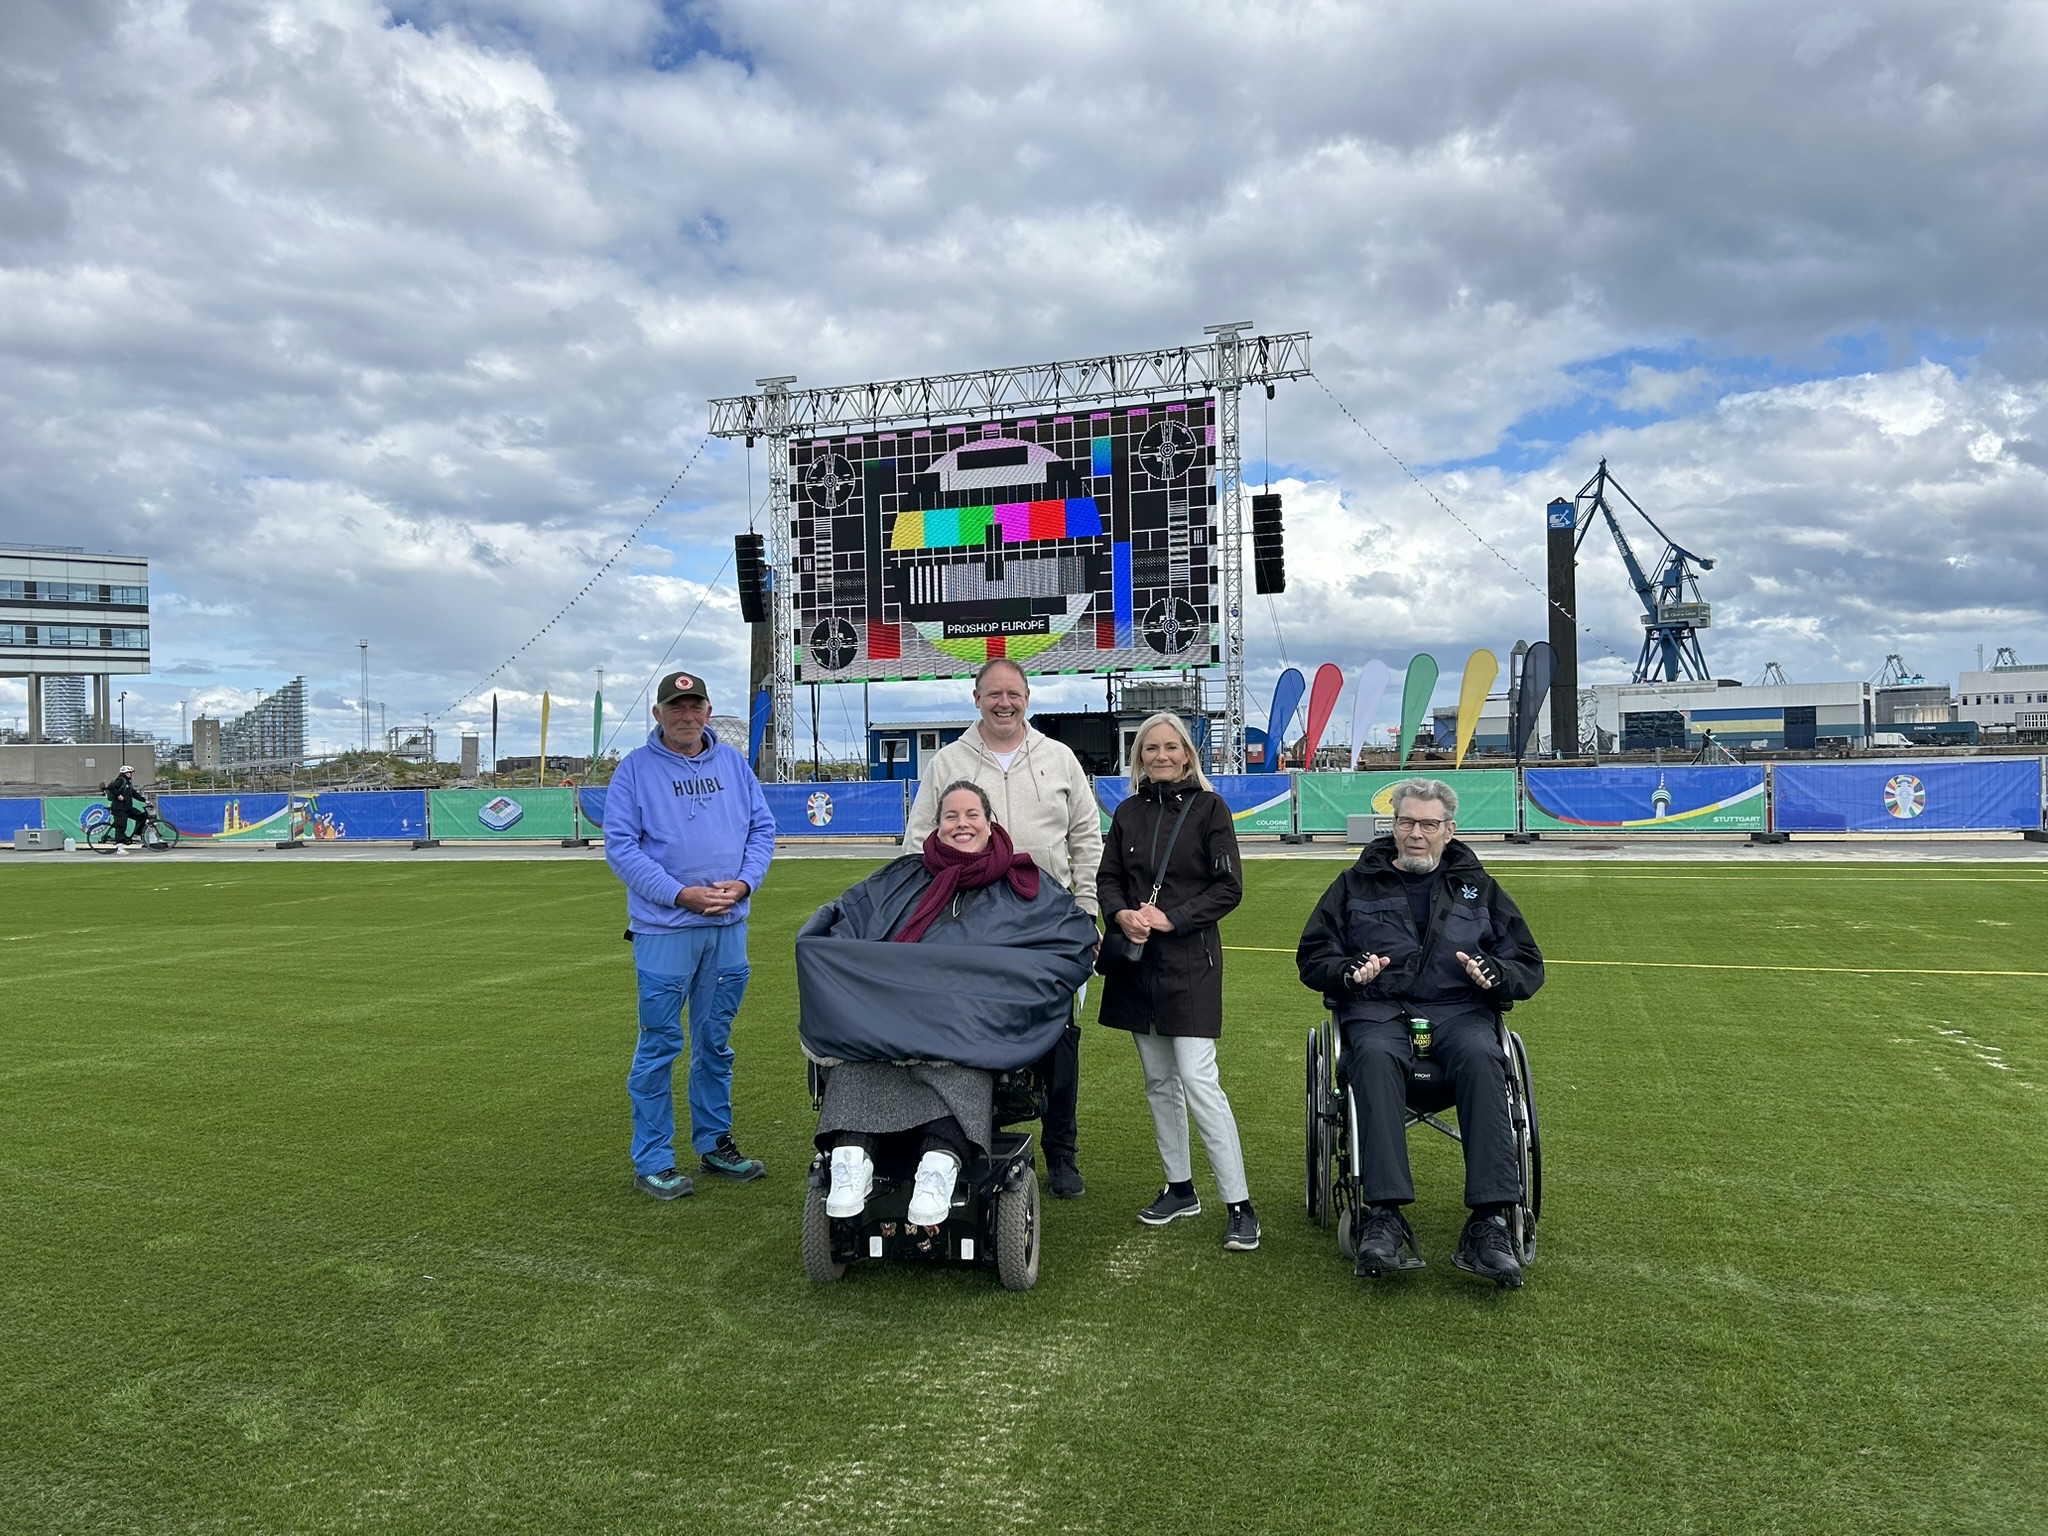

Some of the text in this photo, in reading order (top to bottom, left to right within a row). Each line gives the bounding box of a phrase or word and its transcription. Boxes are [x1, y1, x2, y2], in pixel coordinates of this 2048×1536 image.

[947, 620, 1046, 634] PROSHOP EUROPE
[672, 776, 725, 797] HUMBL
